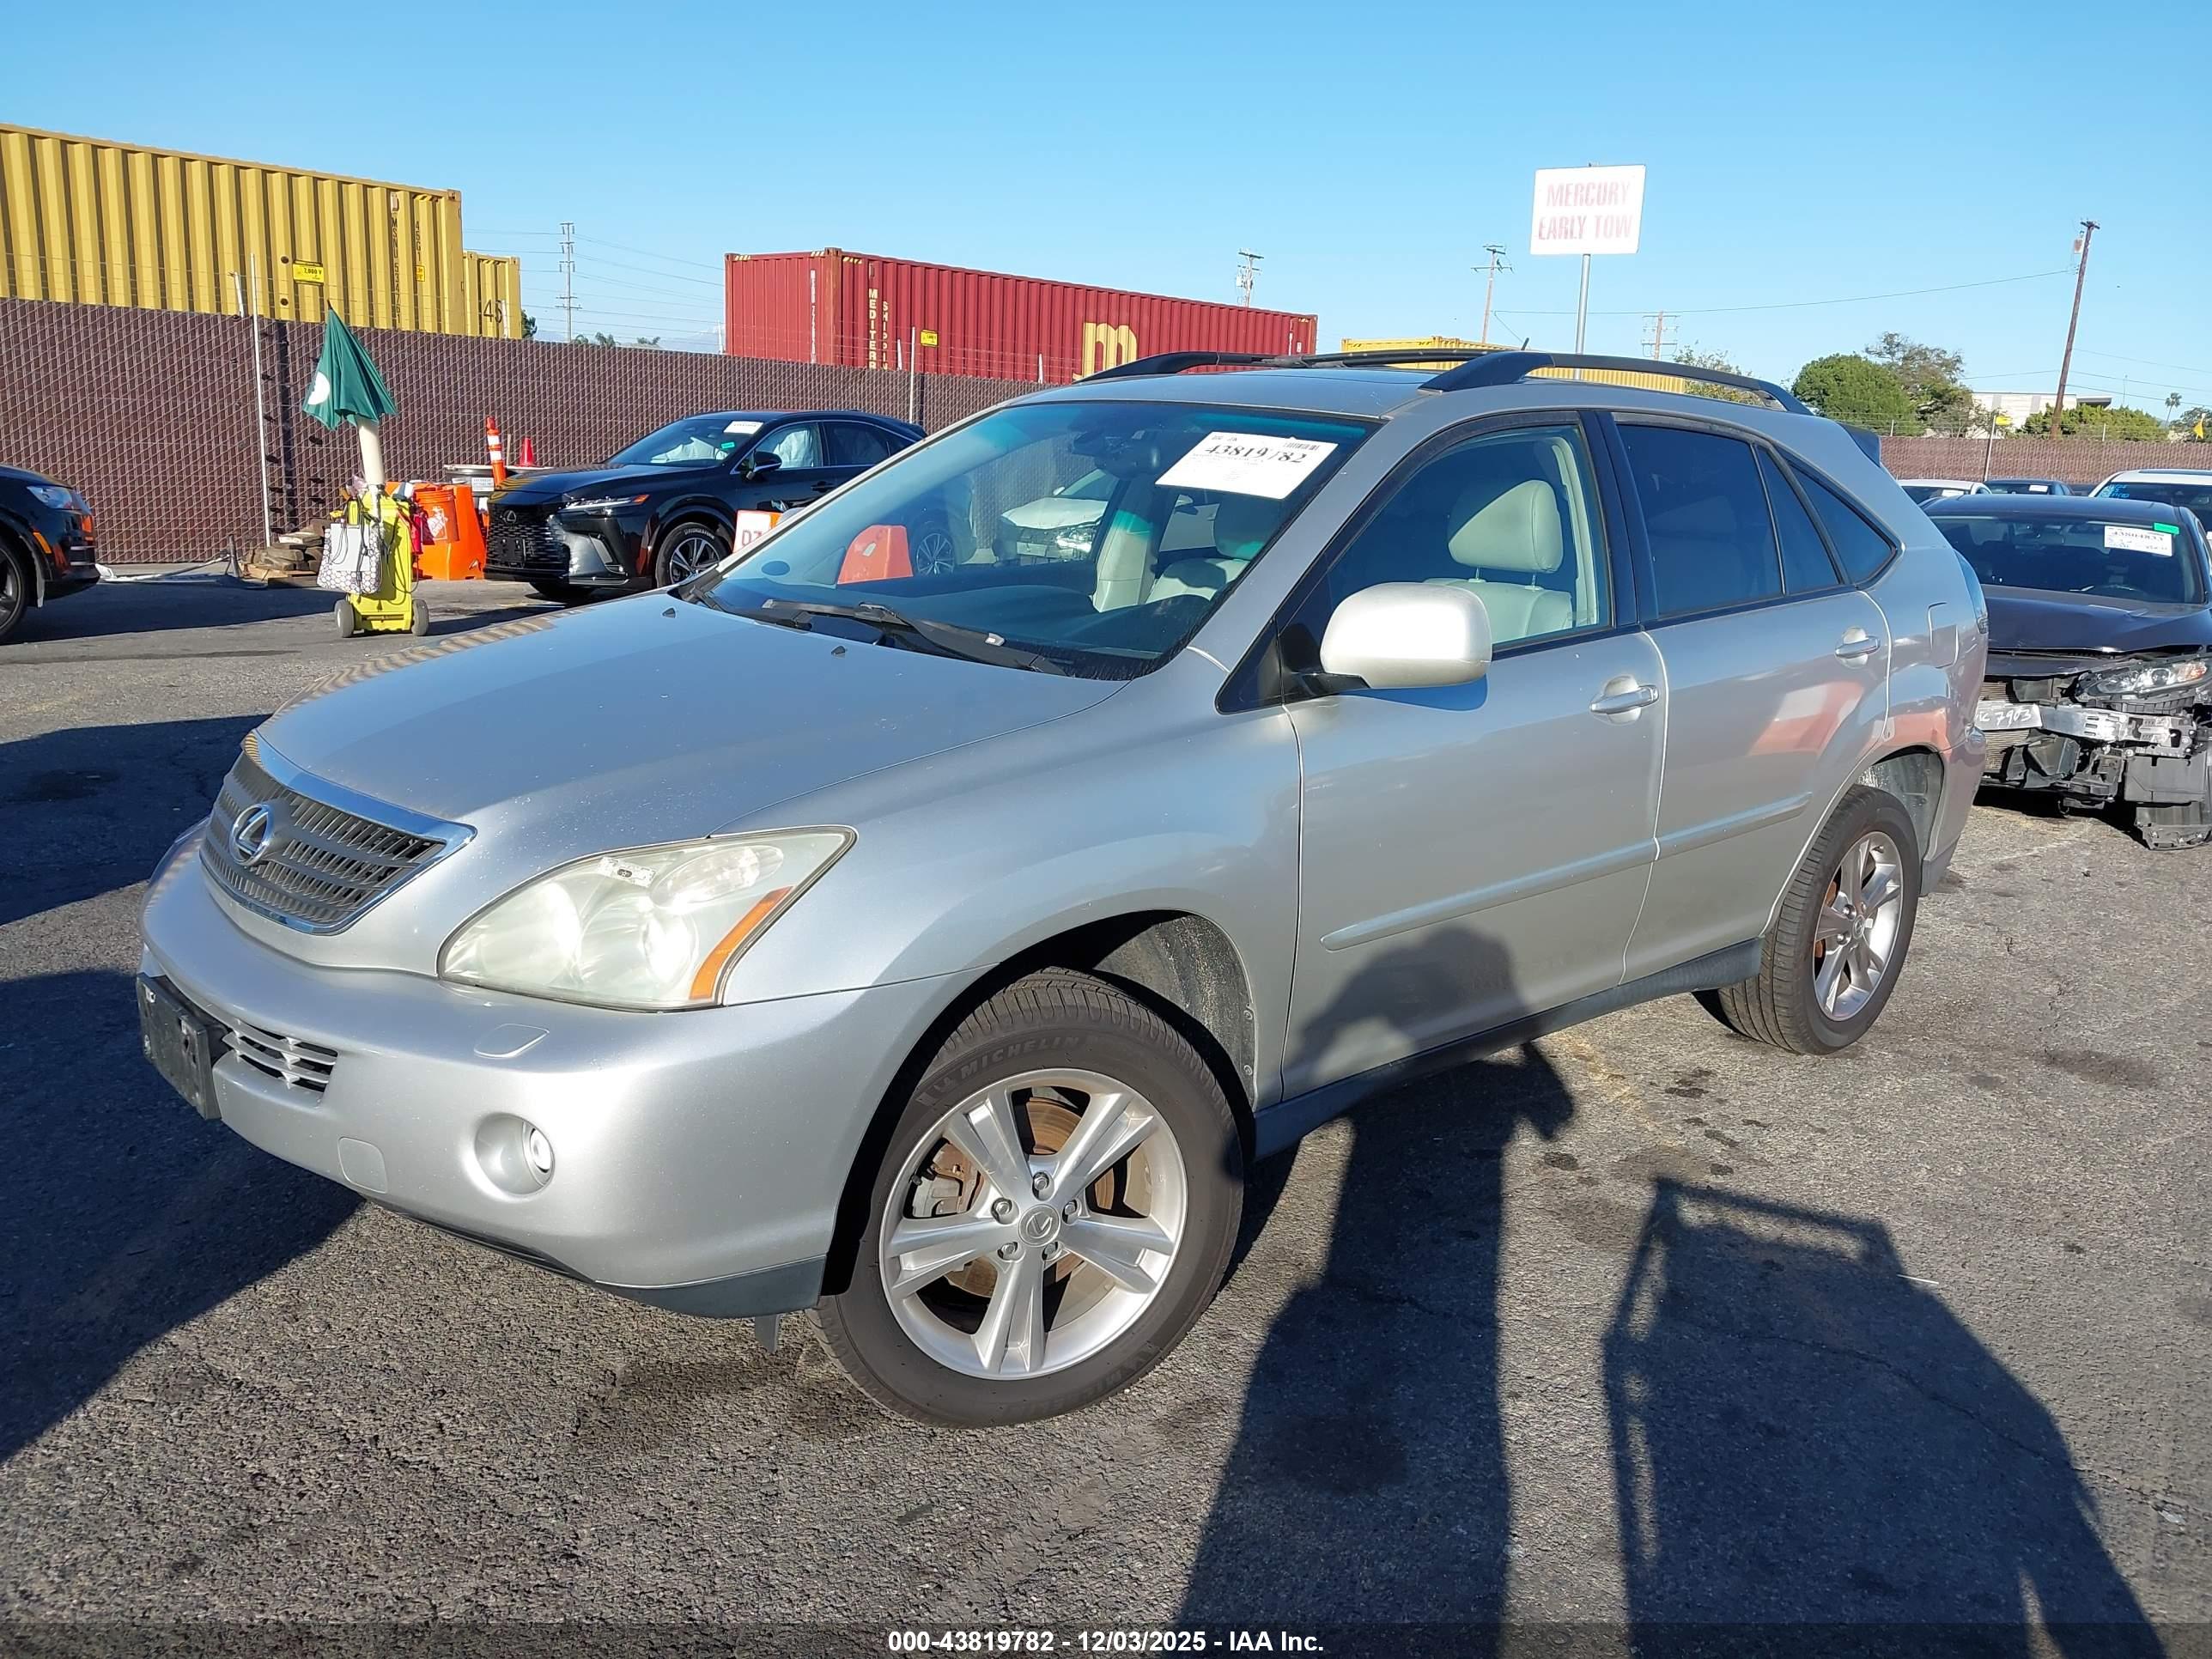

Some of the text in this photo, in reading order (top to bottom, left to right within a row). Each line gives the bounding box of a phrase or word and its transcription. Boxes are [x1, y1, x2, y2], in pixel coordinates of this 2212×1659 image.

[1546, 180, 1630, 207] MERCURY
[1538, 214, 1632, 240] EARLY TOW
[1995, 709, 2033, 728] 7903
[961, 1036, 1080, 1080] MICHELIN
